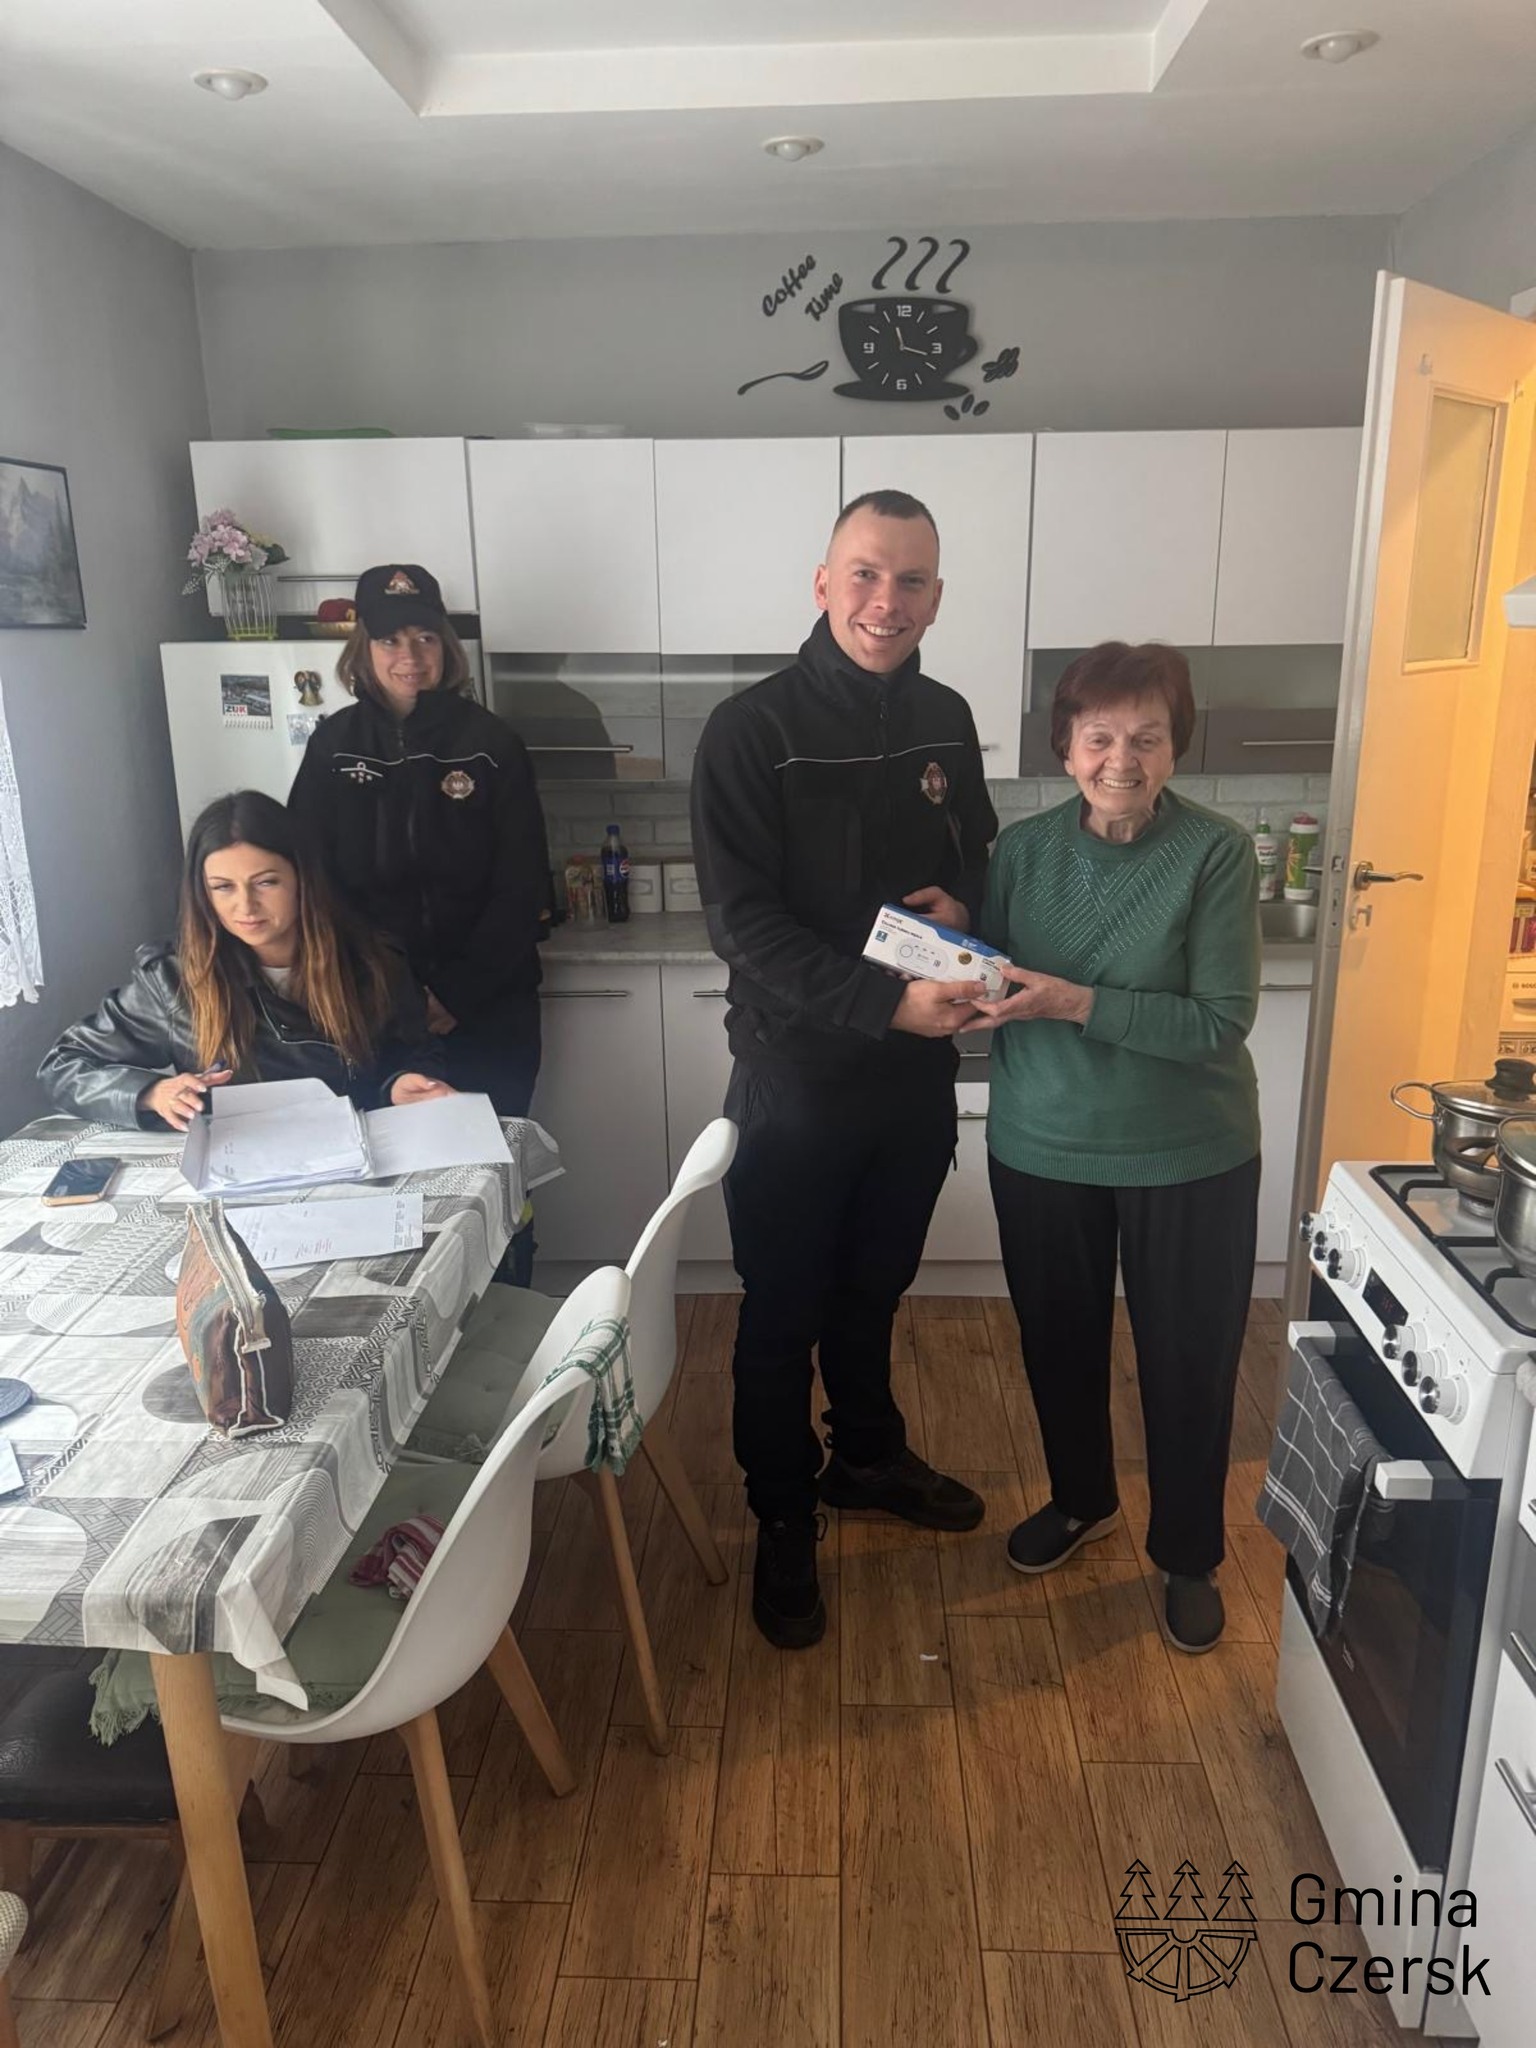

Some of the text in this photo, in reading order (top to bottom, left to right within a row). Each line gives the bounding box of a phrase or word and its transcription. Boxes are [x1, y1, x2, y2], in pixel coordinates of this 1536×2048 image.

[763, 255, 816, 317] Coffee
[896, 305, 912, 317] 12
[863, 342, 875, 354] 9
[931, 342, 942, 354] 3
[896, 378, 907, 390] 6
